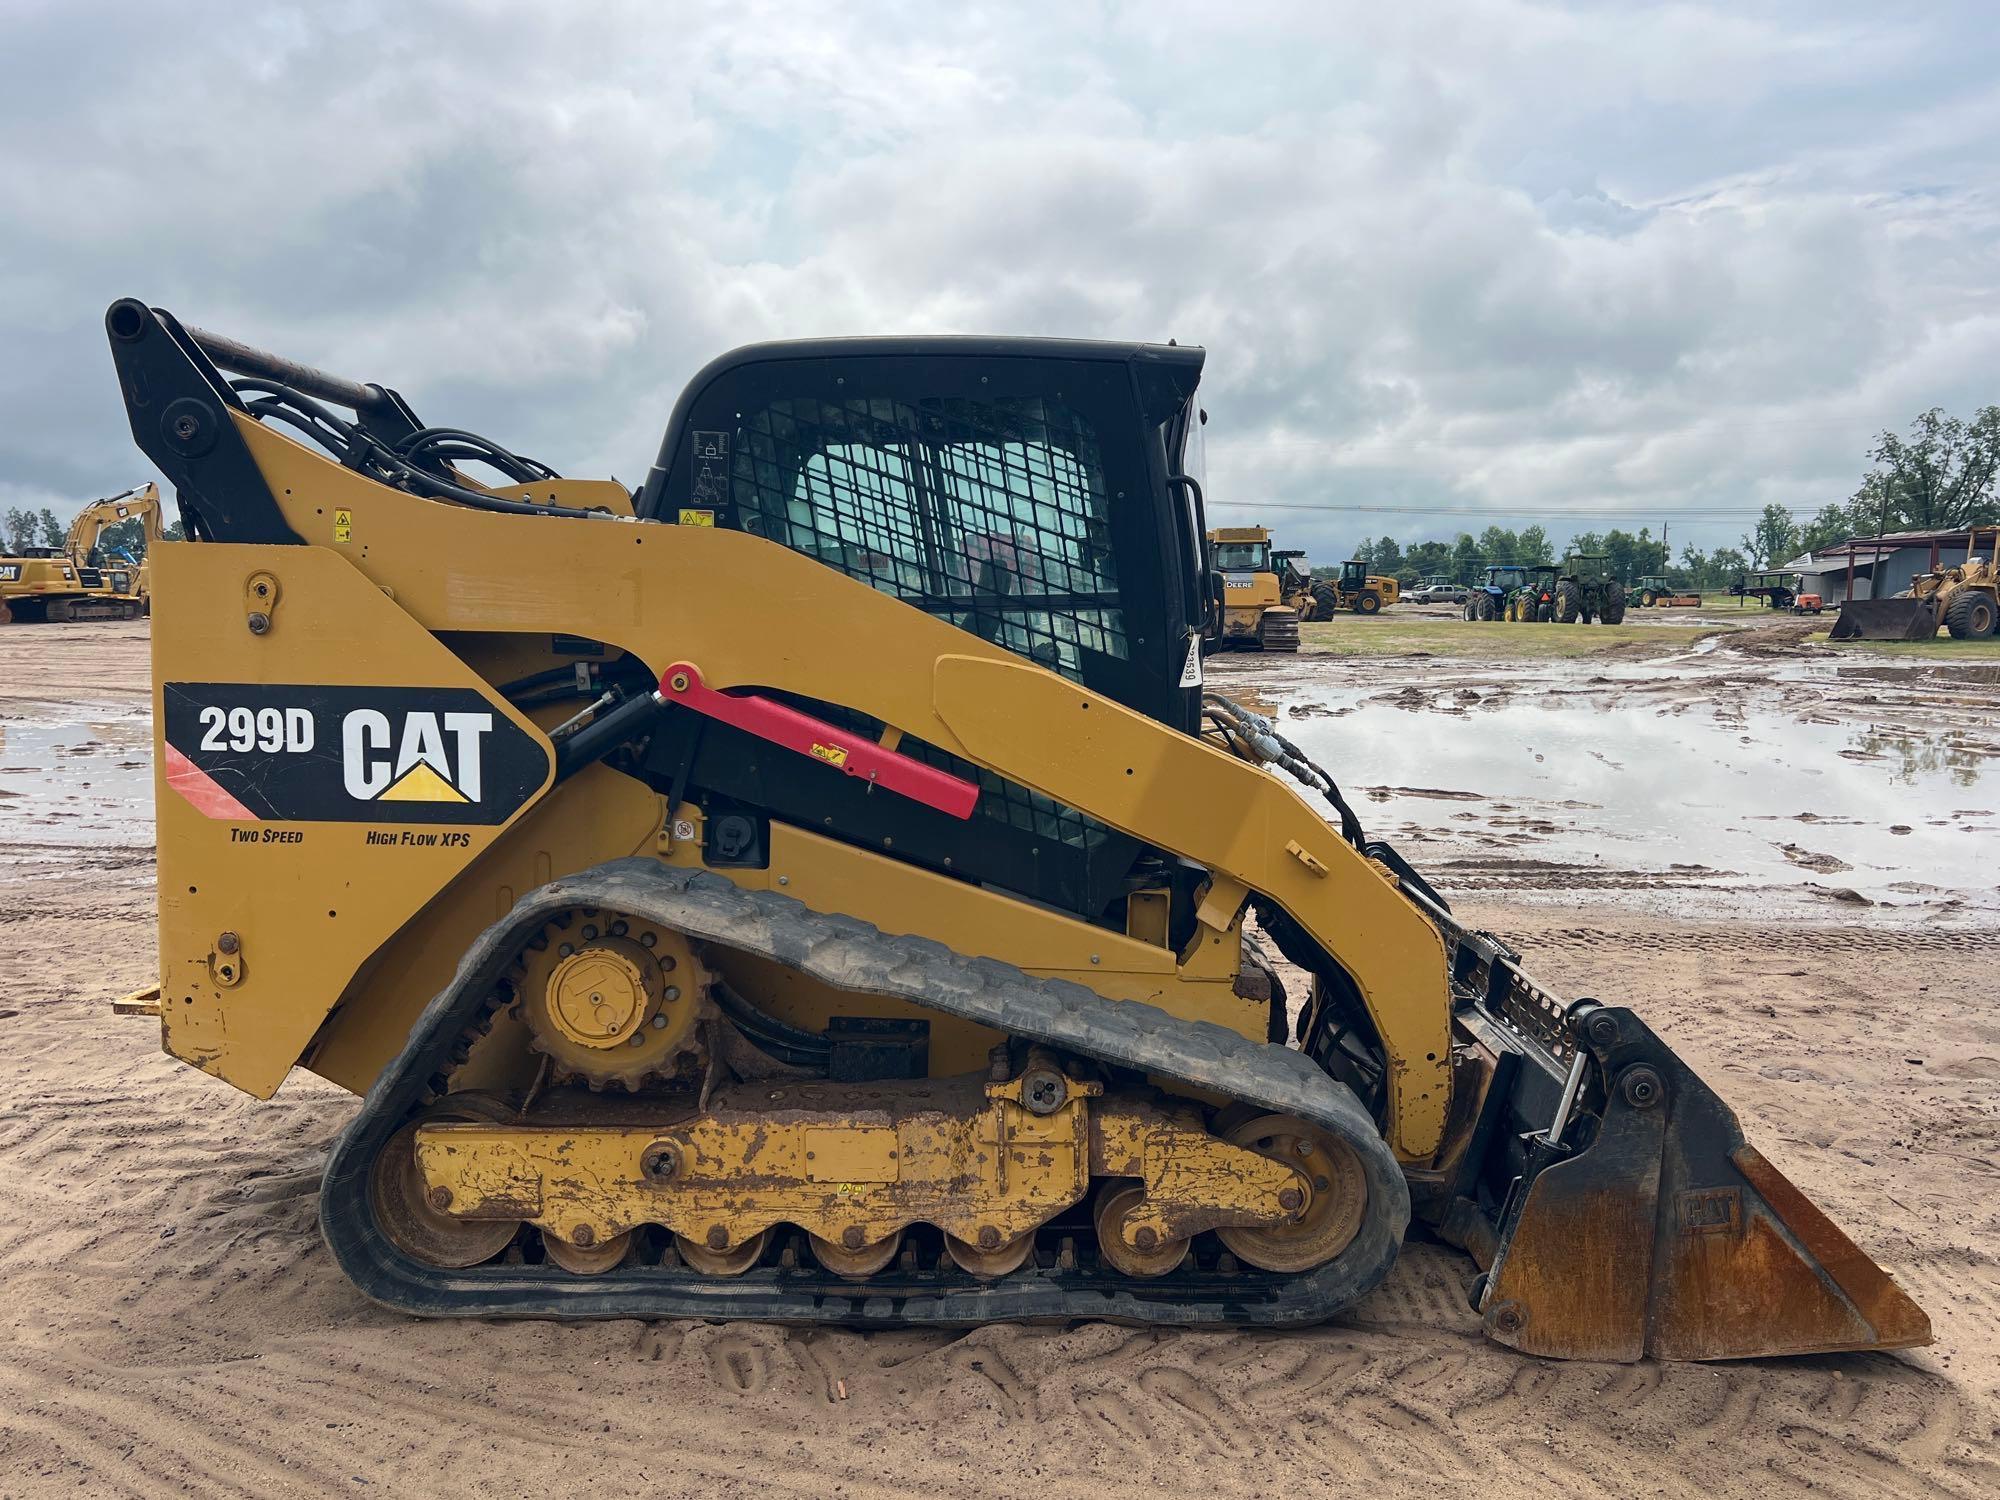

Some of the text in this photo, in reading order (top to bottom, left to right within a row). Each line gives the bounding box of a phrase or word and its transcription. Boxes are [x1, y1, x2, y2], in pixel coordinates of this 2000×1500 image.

[0, 567, 16, 579] CAT
[199, 706, 315, 753] 299D
[342, 708, 493, 803] CAT
[231, 828, 303, 843] TWO SPEED
[366, 831, 471, 847] HIGH FLOW XPS
